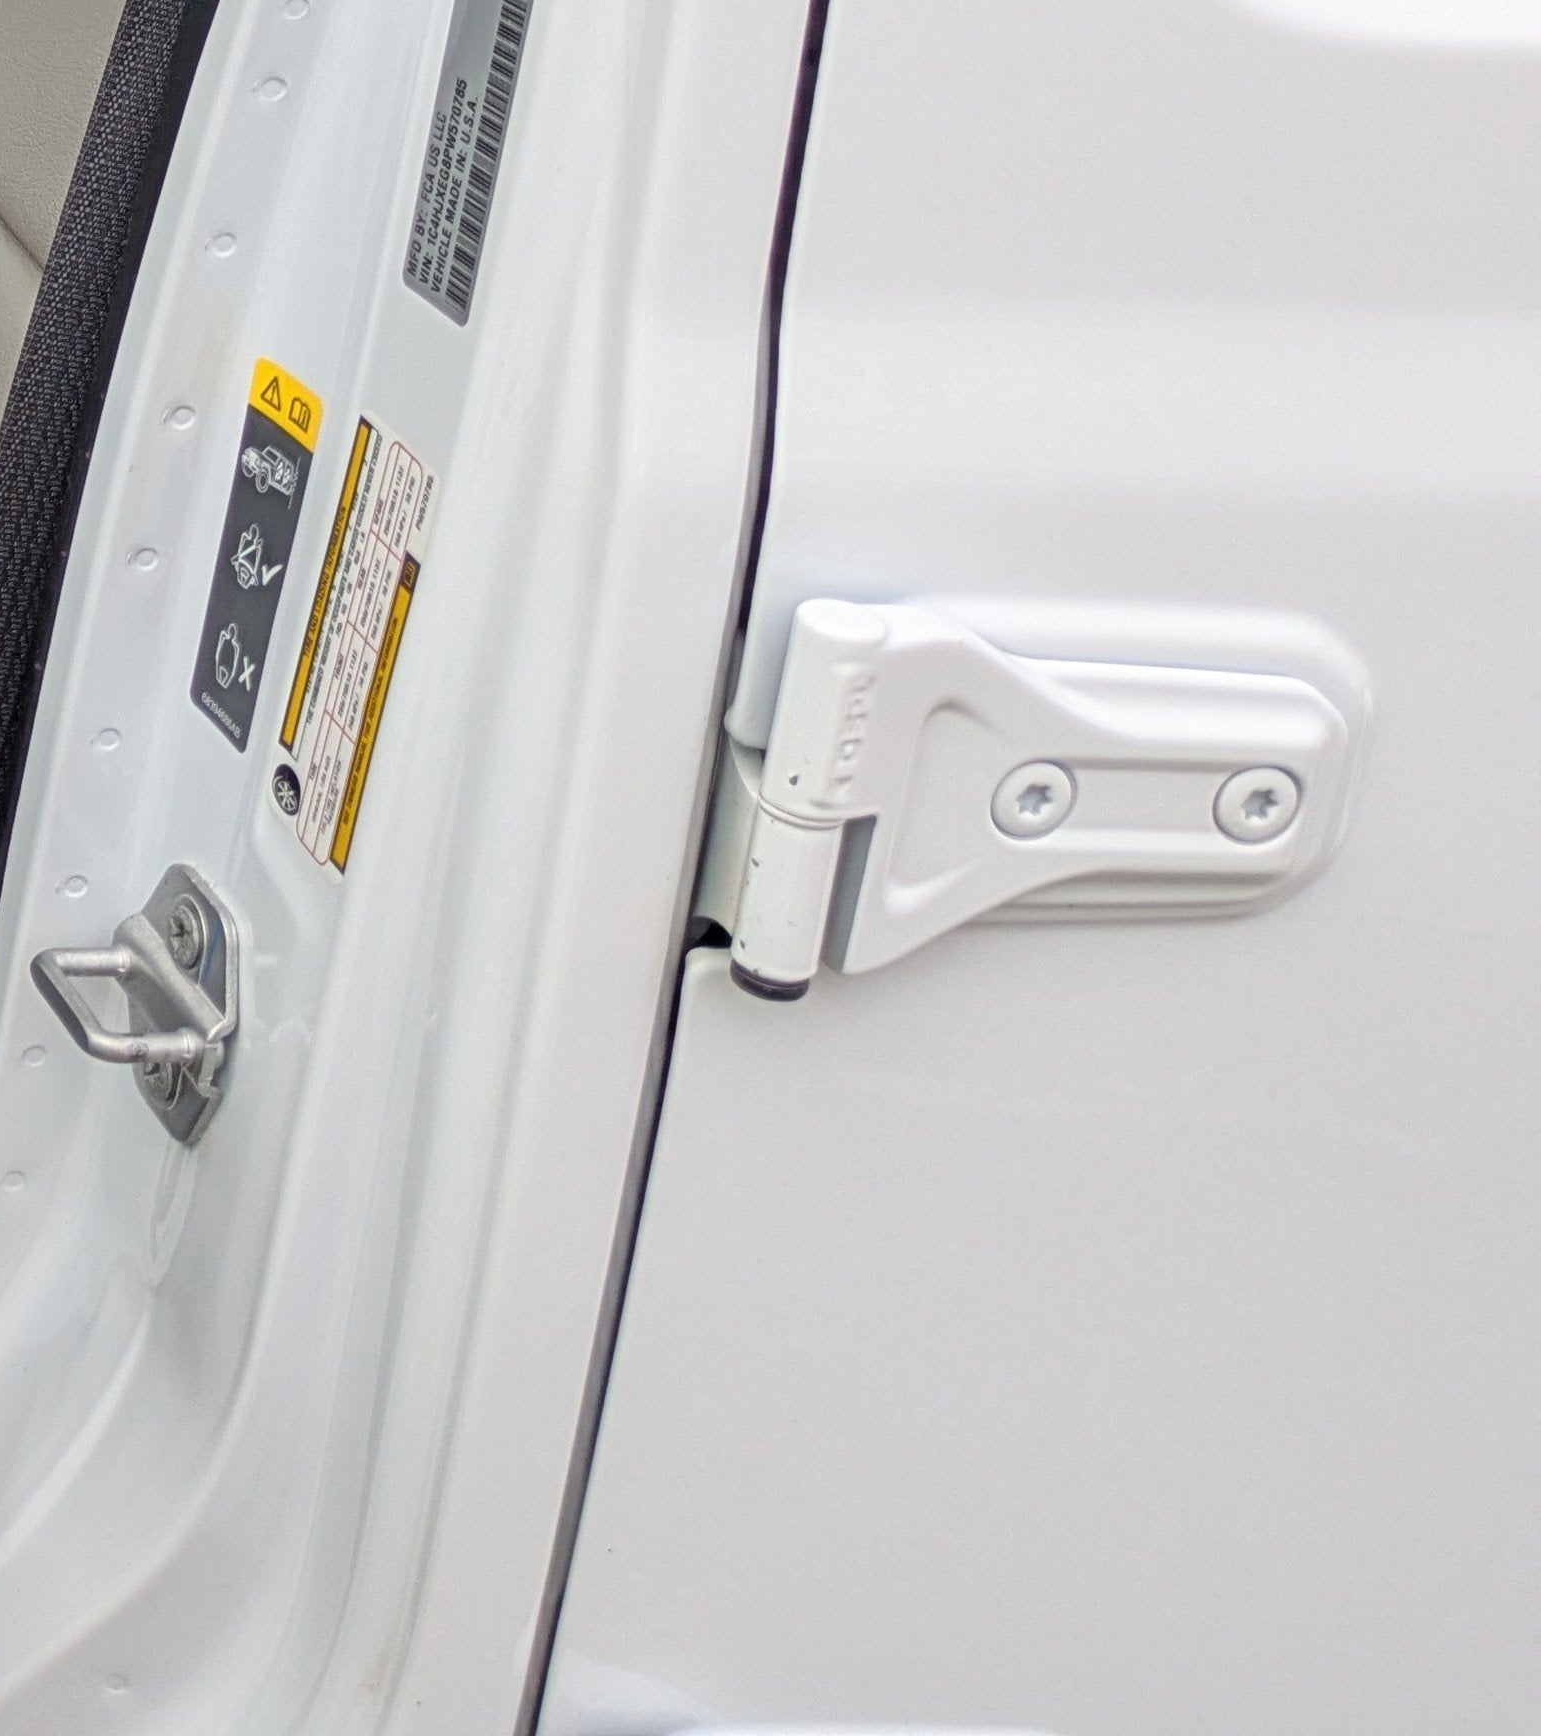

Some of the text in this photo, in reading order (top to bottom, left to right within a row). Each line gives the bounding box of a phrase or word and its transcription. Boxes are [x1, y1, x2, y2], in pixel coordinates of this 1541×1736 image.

[407, 112, 446, 277] MFD BY: FCA US LLC
[419, 78, 467, 284] VIN: 1C4HJXEG8PW570785
[431, 96, 478, 292] VEHICLE MADE IN: U.S.A.
